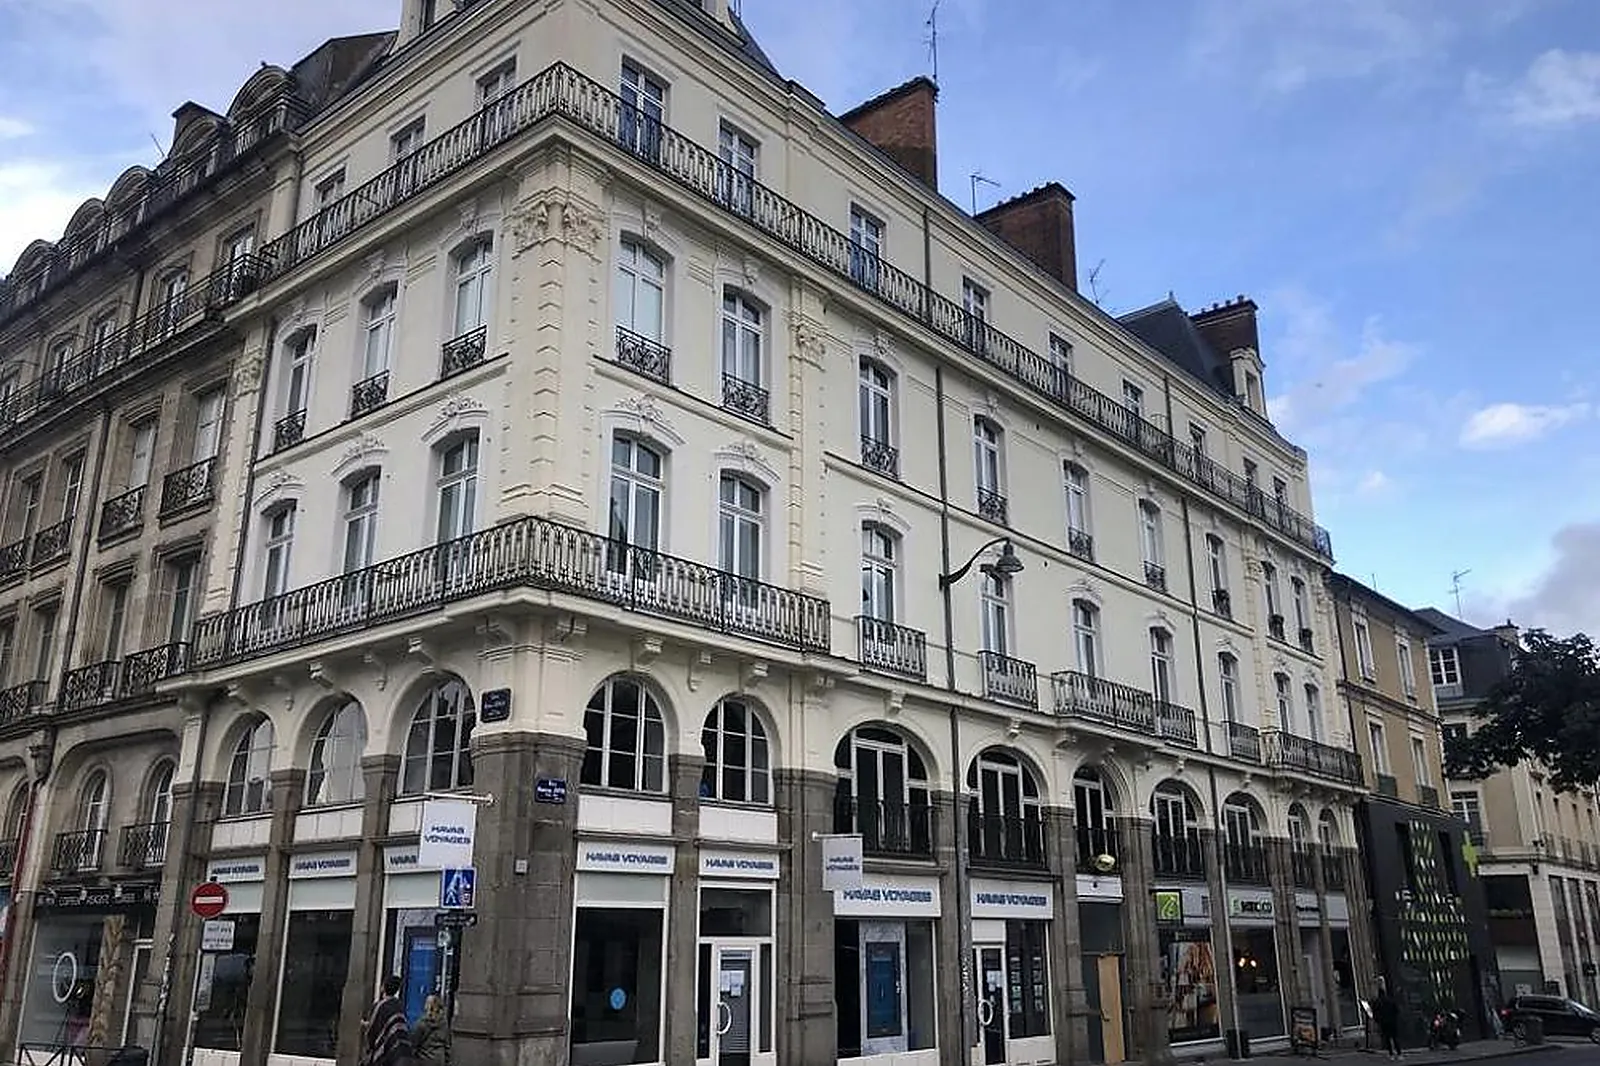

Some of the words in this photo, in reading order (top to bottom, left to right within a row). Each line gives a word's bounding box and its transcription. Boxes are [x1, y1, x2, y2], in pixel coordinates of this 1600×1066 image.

[432, 826, 466, 834] HAVAS
[424, 835, 471, 845] VOYAGES
[586, 852, 620, 862] HAVAS
[622, 854, 668, 865] VOYAGES
[706, 858, 735, 868] HAVAS
[736, 860, 774, 870] VOYAGES
[843, 888, 881, 901] HAVAS
[882, 889, 932, 903] VOYAGES
[976, 892, 1006, 904] HAVAS
[1007, 894, 1047, 907] VOYAGES
